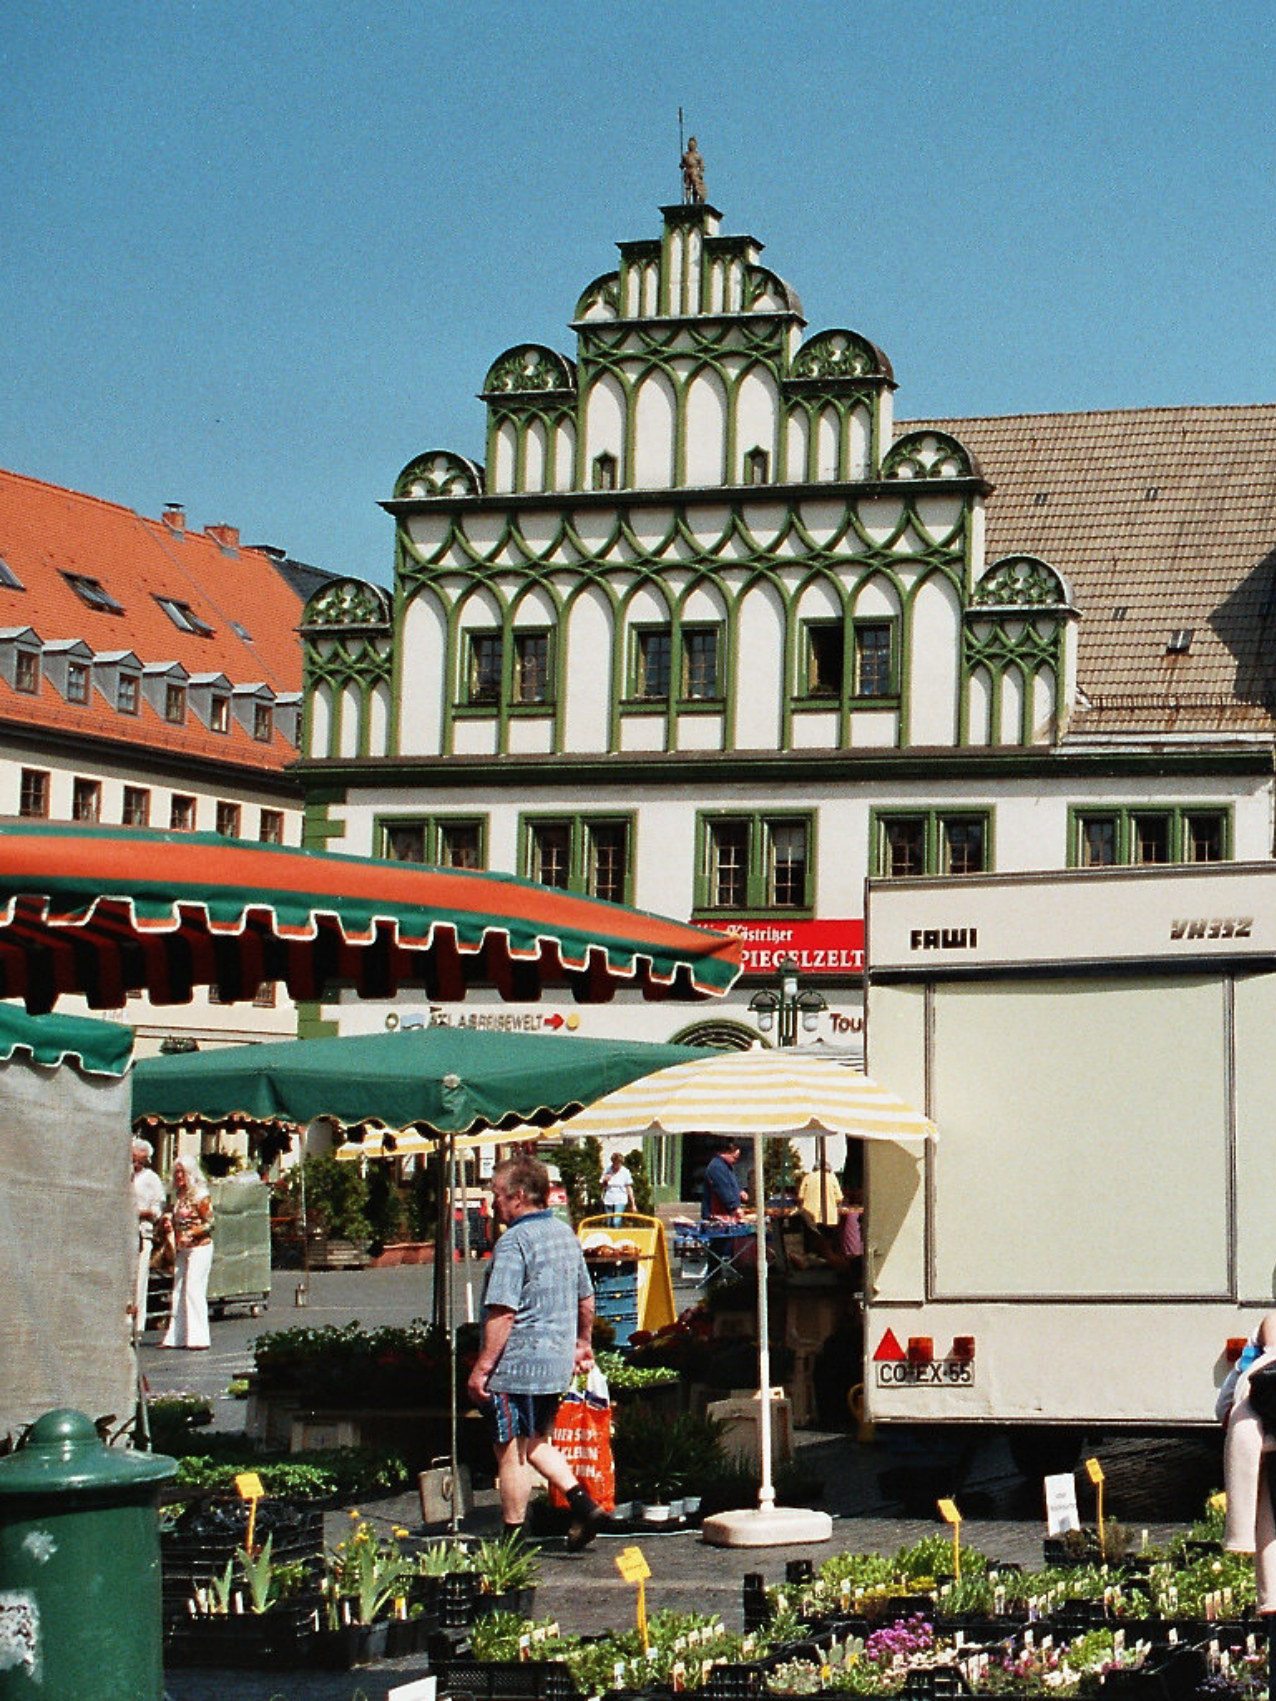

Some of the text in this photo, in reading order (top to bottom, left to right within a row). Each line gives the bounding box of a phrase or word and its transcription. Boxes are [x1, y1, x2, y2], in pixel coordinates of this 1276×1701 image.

[911, 928, 977, 950] FAWI
[742, 949, 864, 968] PIEGELZELT
[830, 1013, 863, 1033] Tou
